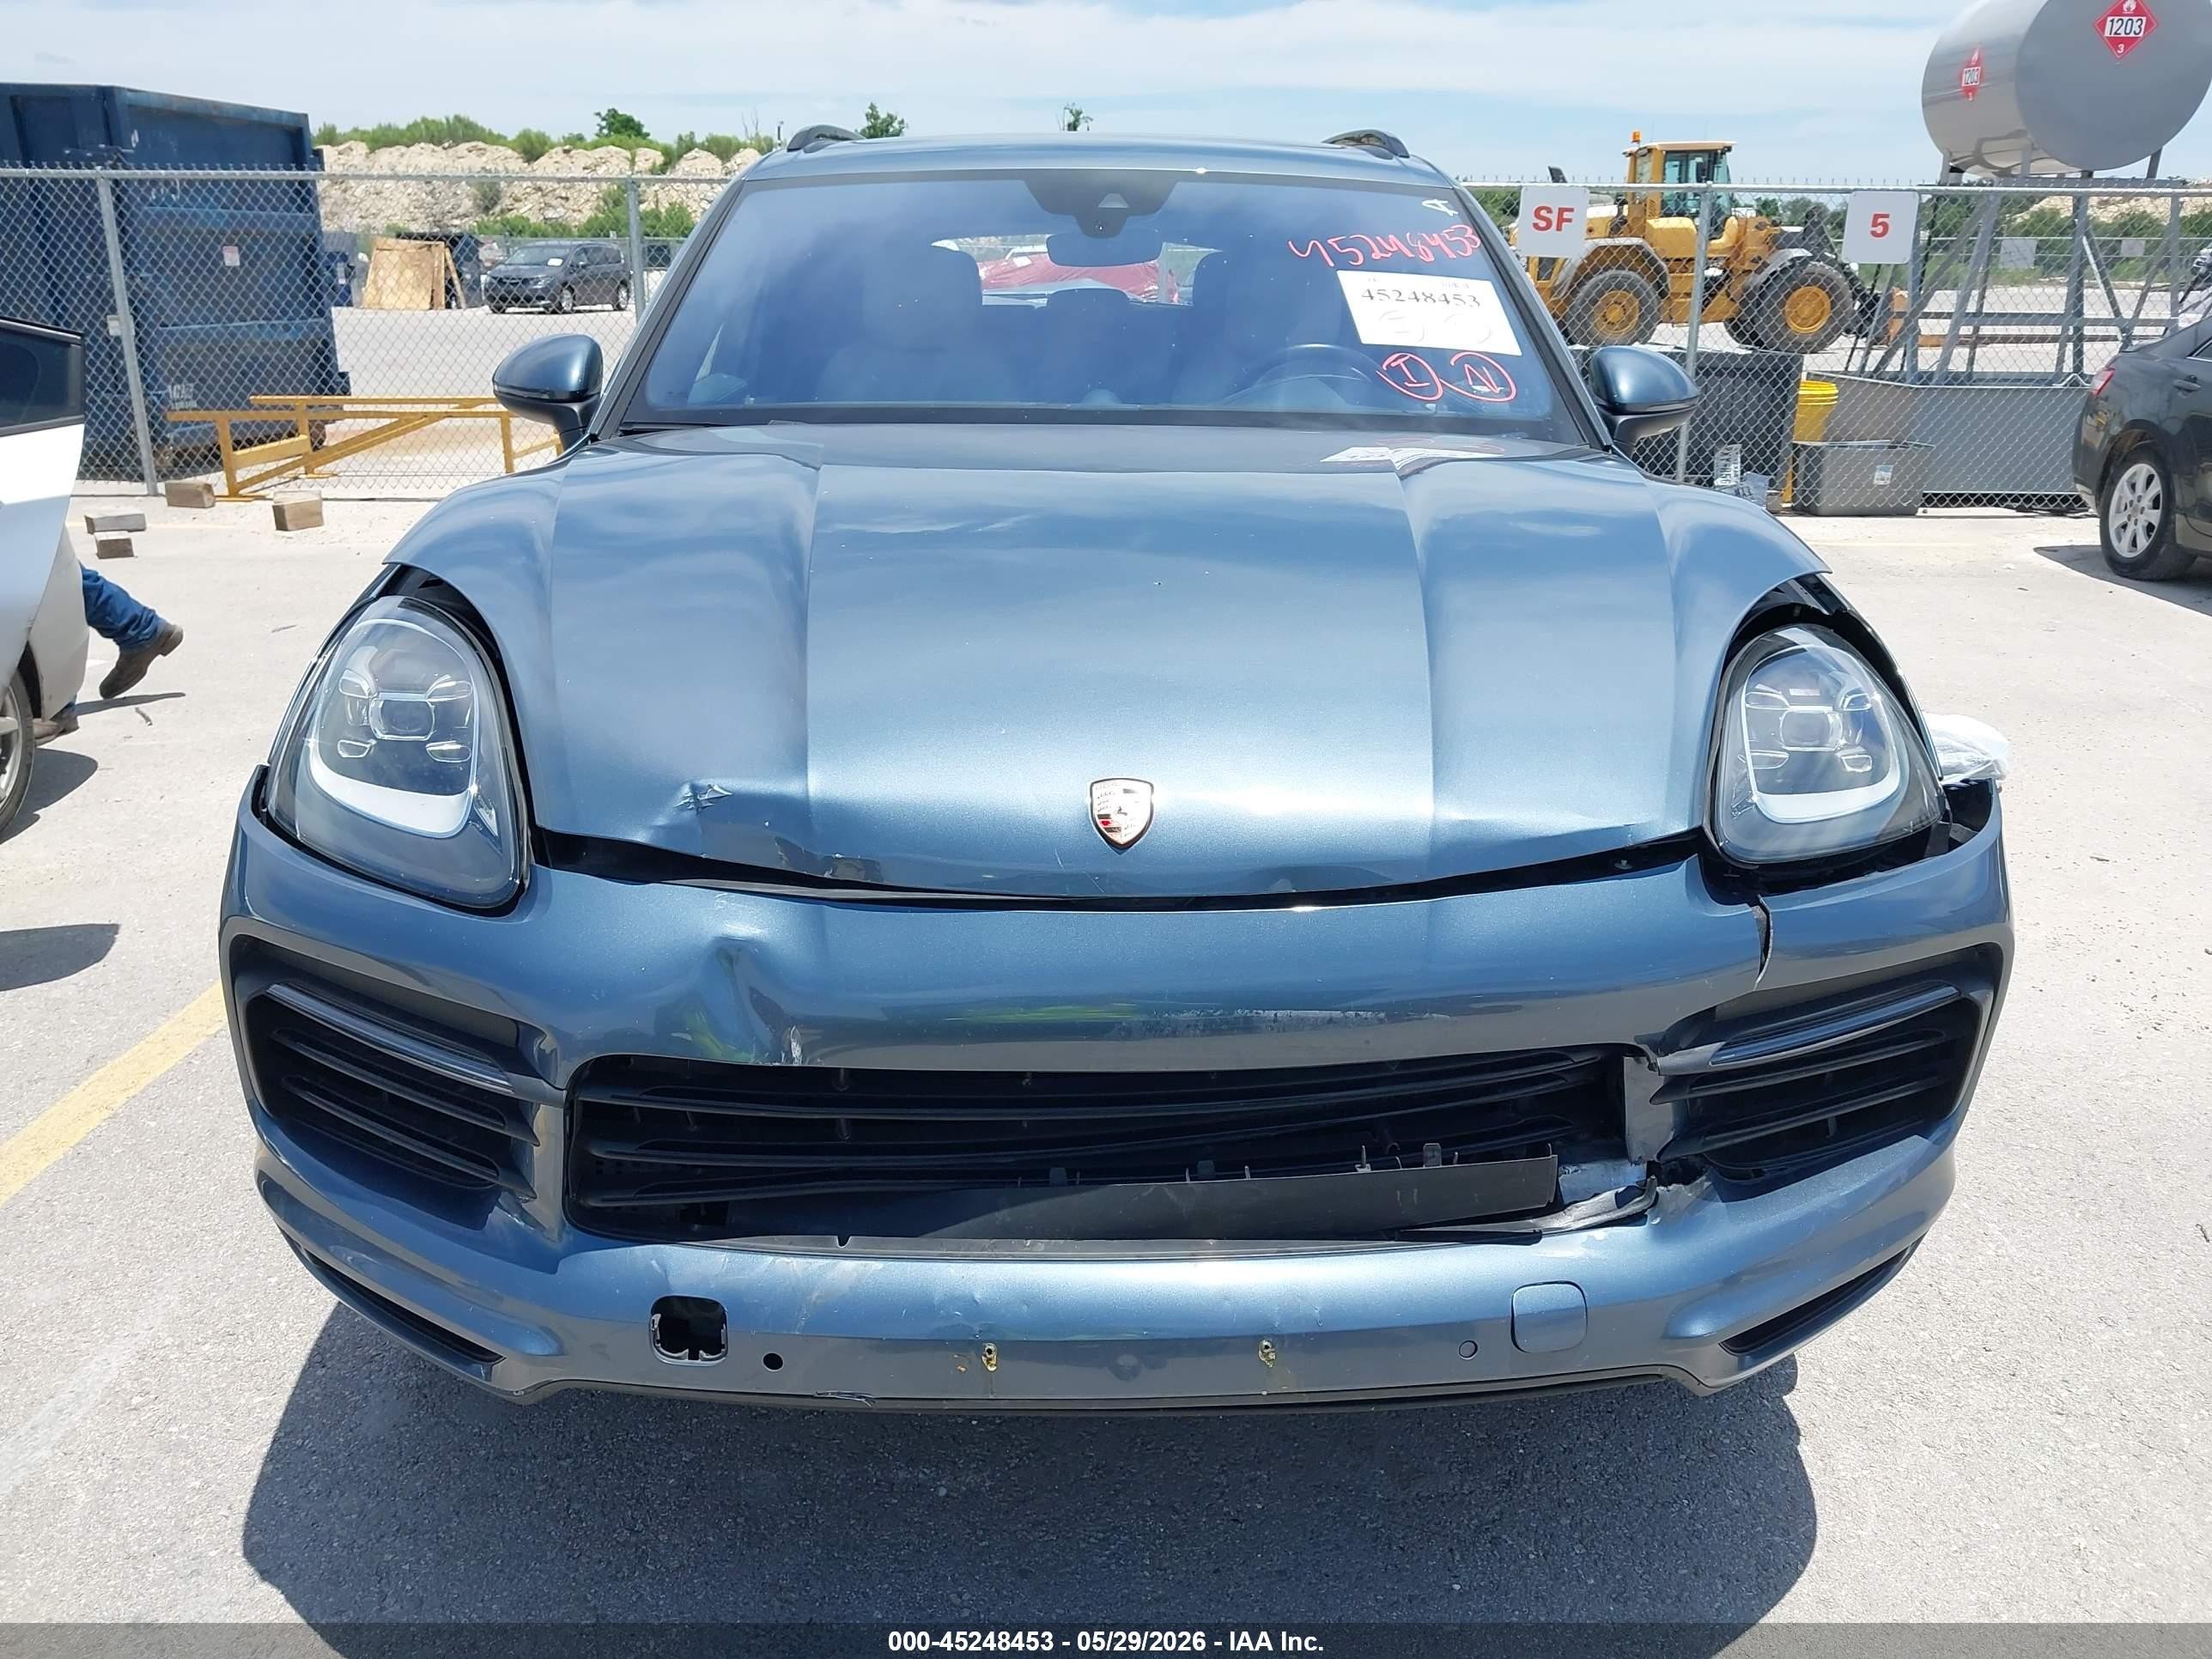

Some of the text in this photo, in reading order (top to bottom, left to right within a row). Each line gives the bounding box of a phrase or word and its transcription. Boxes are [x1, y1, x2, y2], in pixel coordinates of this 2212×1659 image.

[2109, 17, 2143, 35] 1203
[2117, 43, 2124, 54] 3
[1965, 68, 1979, 85] 1203
[1532, 205, 1575, 232] SF
[1869, 213, 1890, 238] 5
[1287, 224, 1481, 267] 45248453
[1360, 288, 1481, 307] 45248453
